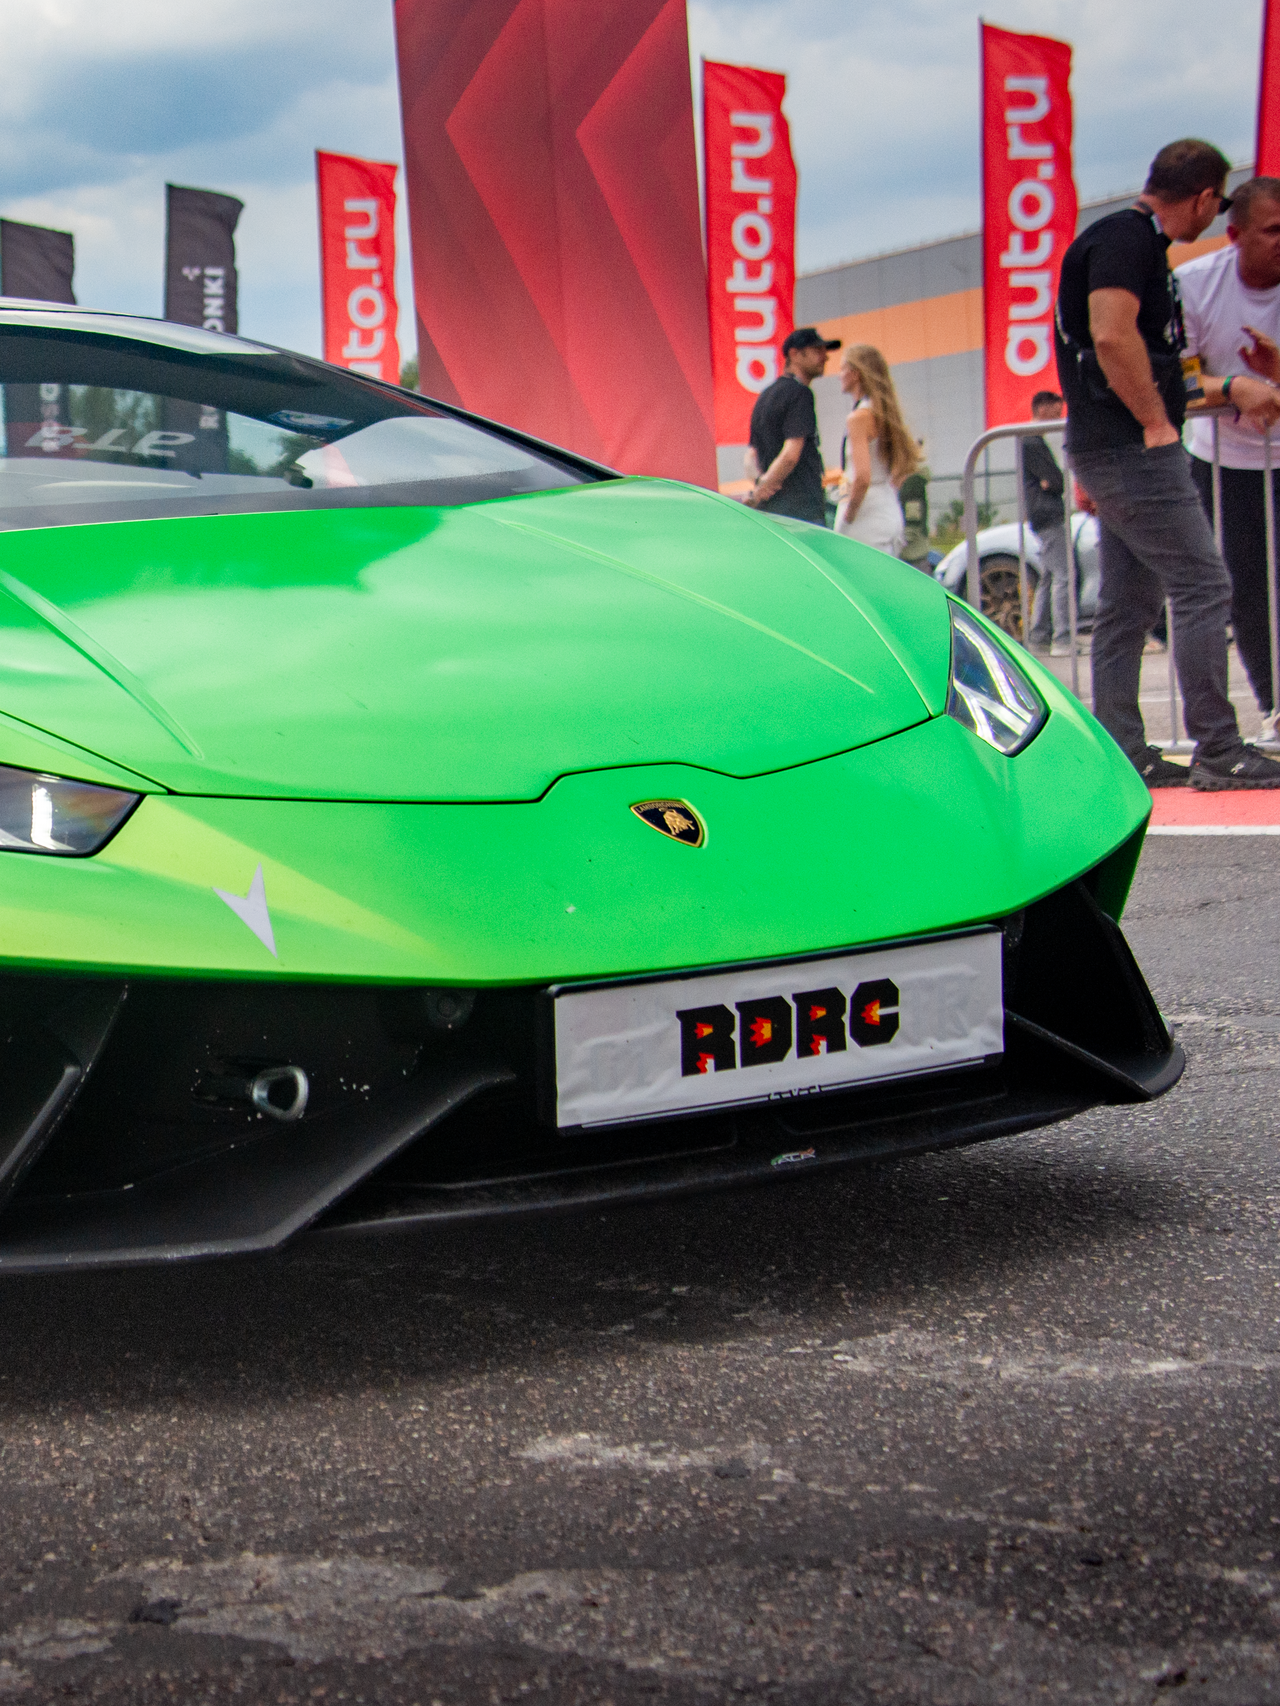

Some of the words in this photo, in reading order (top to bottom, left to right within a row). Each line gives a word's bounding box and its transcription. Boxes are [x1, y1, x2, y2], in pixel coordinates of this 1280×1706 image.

[726, 112, 776, 394] auto.ru
[999, 75, 1054, 376] auto.ru
[676, 978, 900, 1077] RDRC
